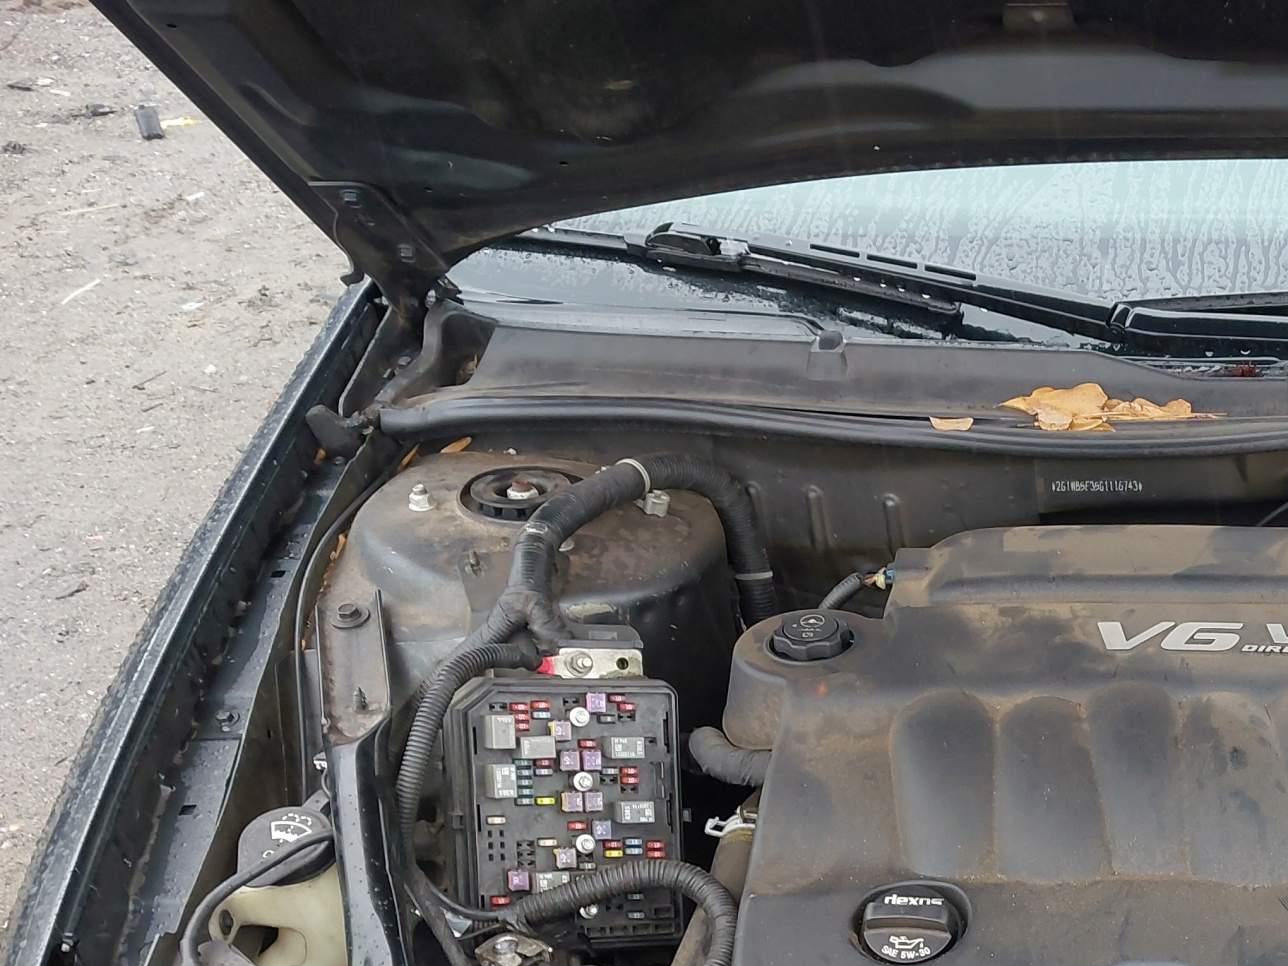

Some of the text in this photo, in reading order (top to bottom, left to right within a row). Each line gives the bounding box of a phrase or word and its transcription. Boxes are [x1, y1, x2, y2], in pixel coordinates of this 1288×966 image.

[1097, 621, 1244, 651] V6
[881, 945, 931, 960] SAE 5W-30
